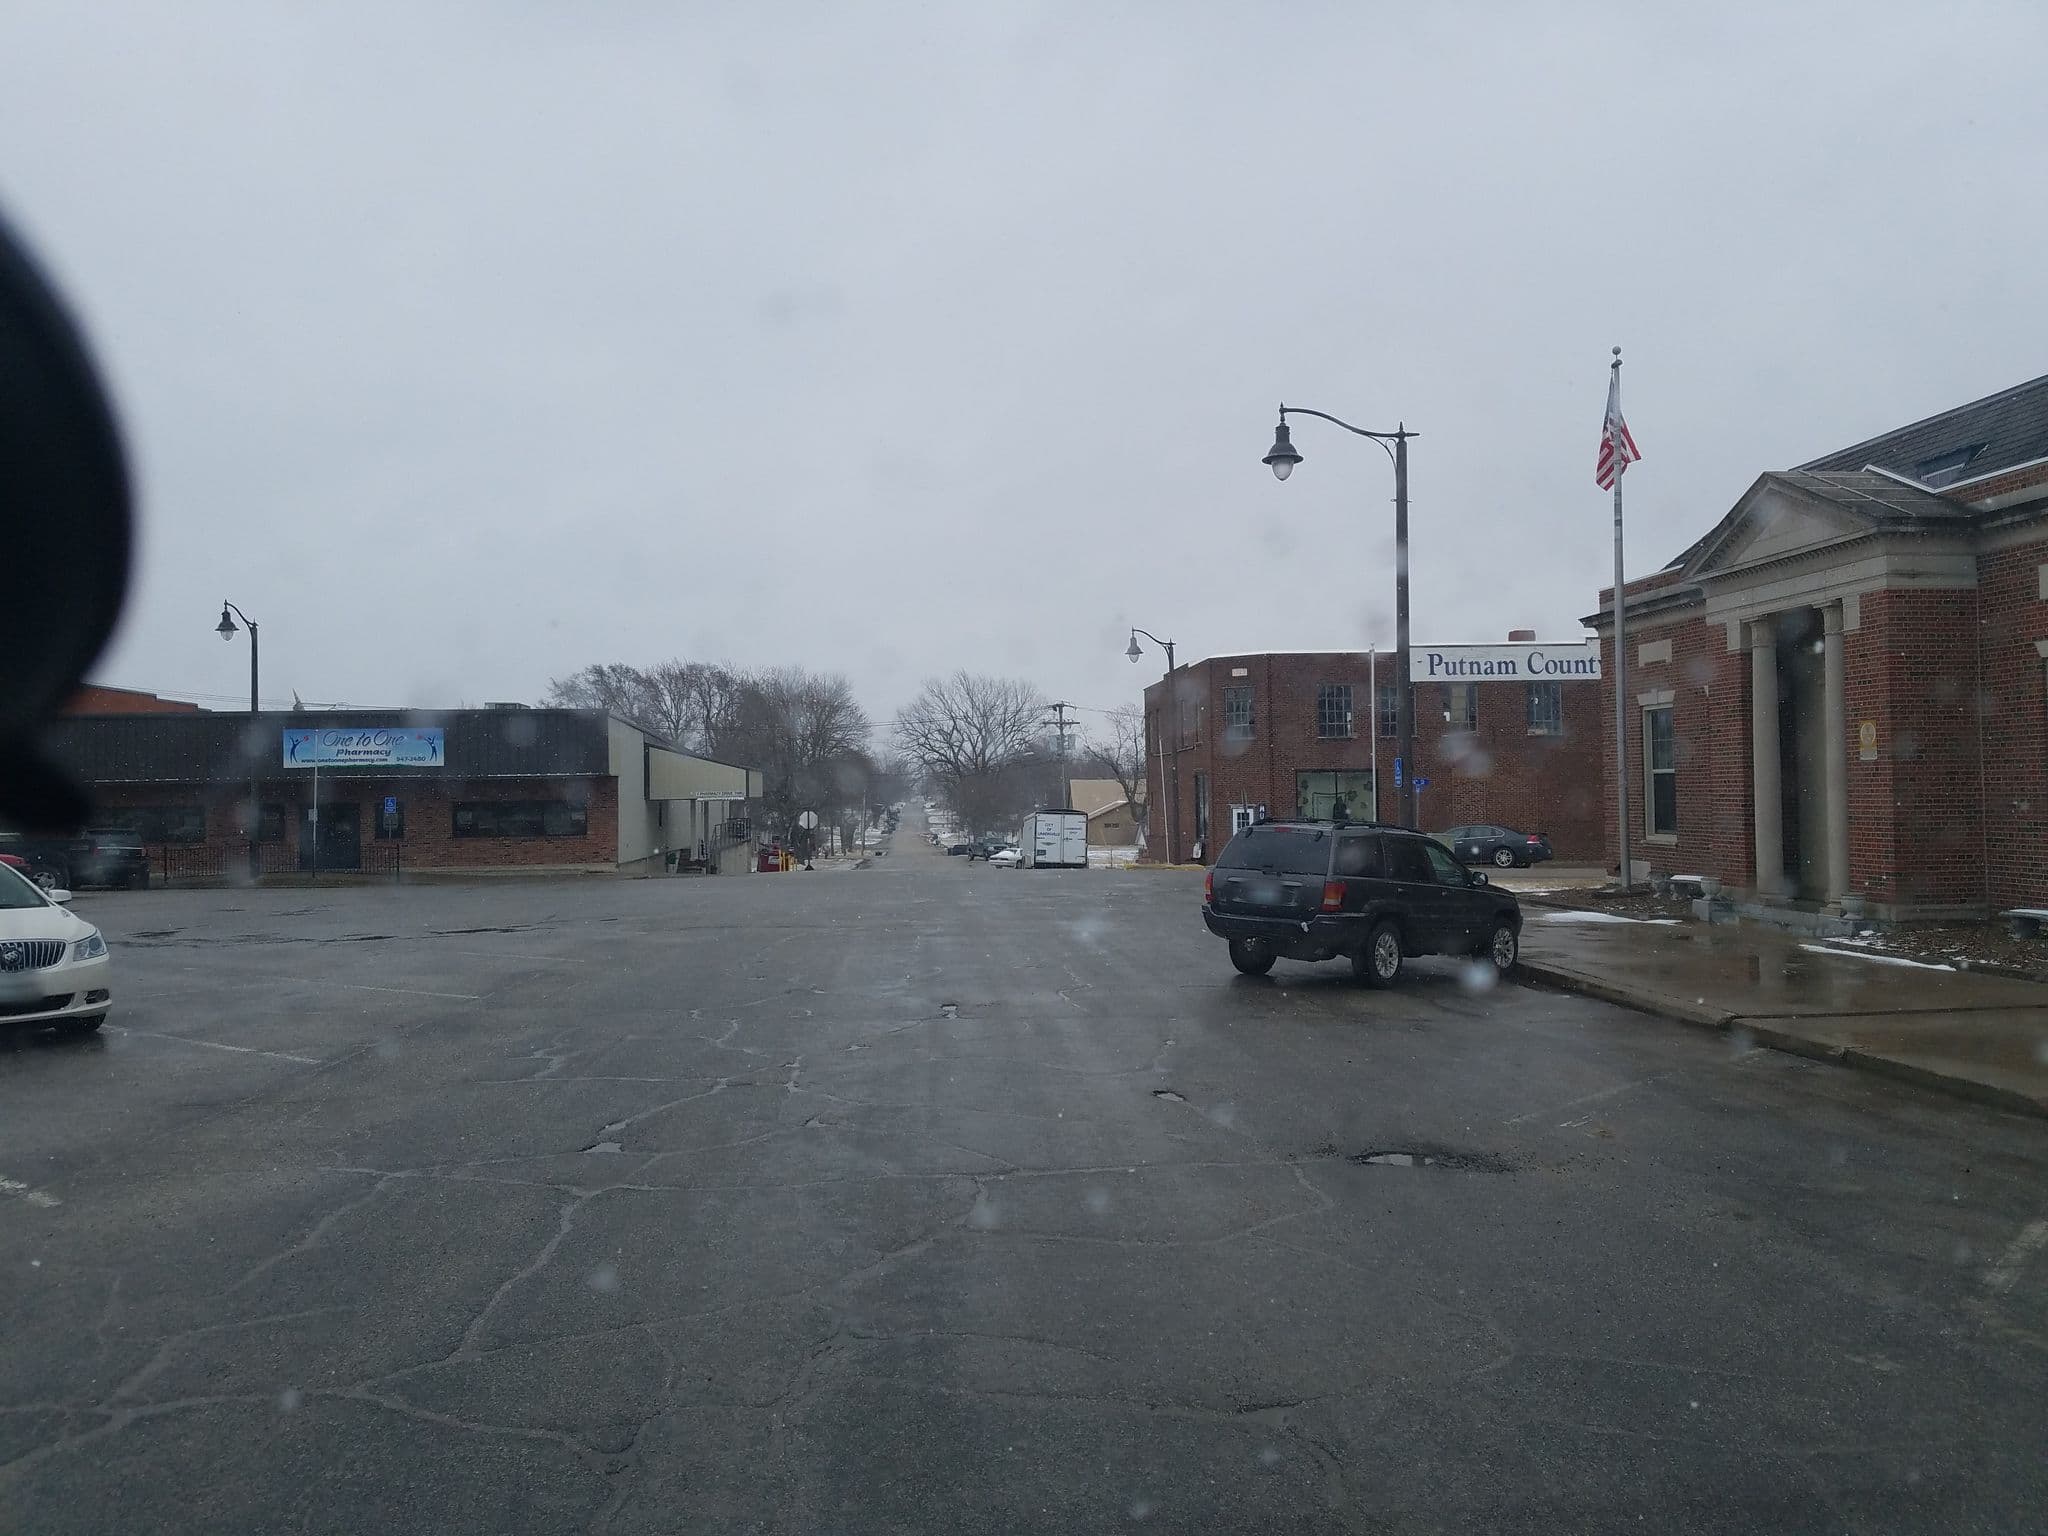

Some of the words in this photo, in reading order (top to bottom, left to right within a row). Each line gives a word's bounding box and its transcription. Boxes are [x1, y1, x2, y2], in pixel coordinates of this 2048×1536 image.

[1427, 653, 1518, 675] Putnam
[323, 730, 353, 746] One
[356, 732, 371, 746] to
[373, 730, 405, 746] One
[336, 749, 392, 757] Pharmacy
